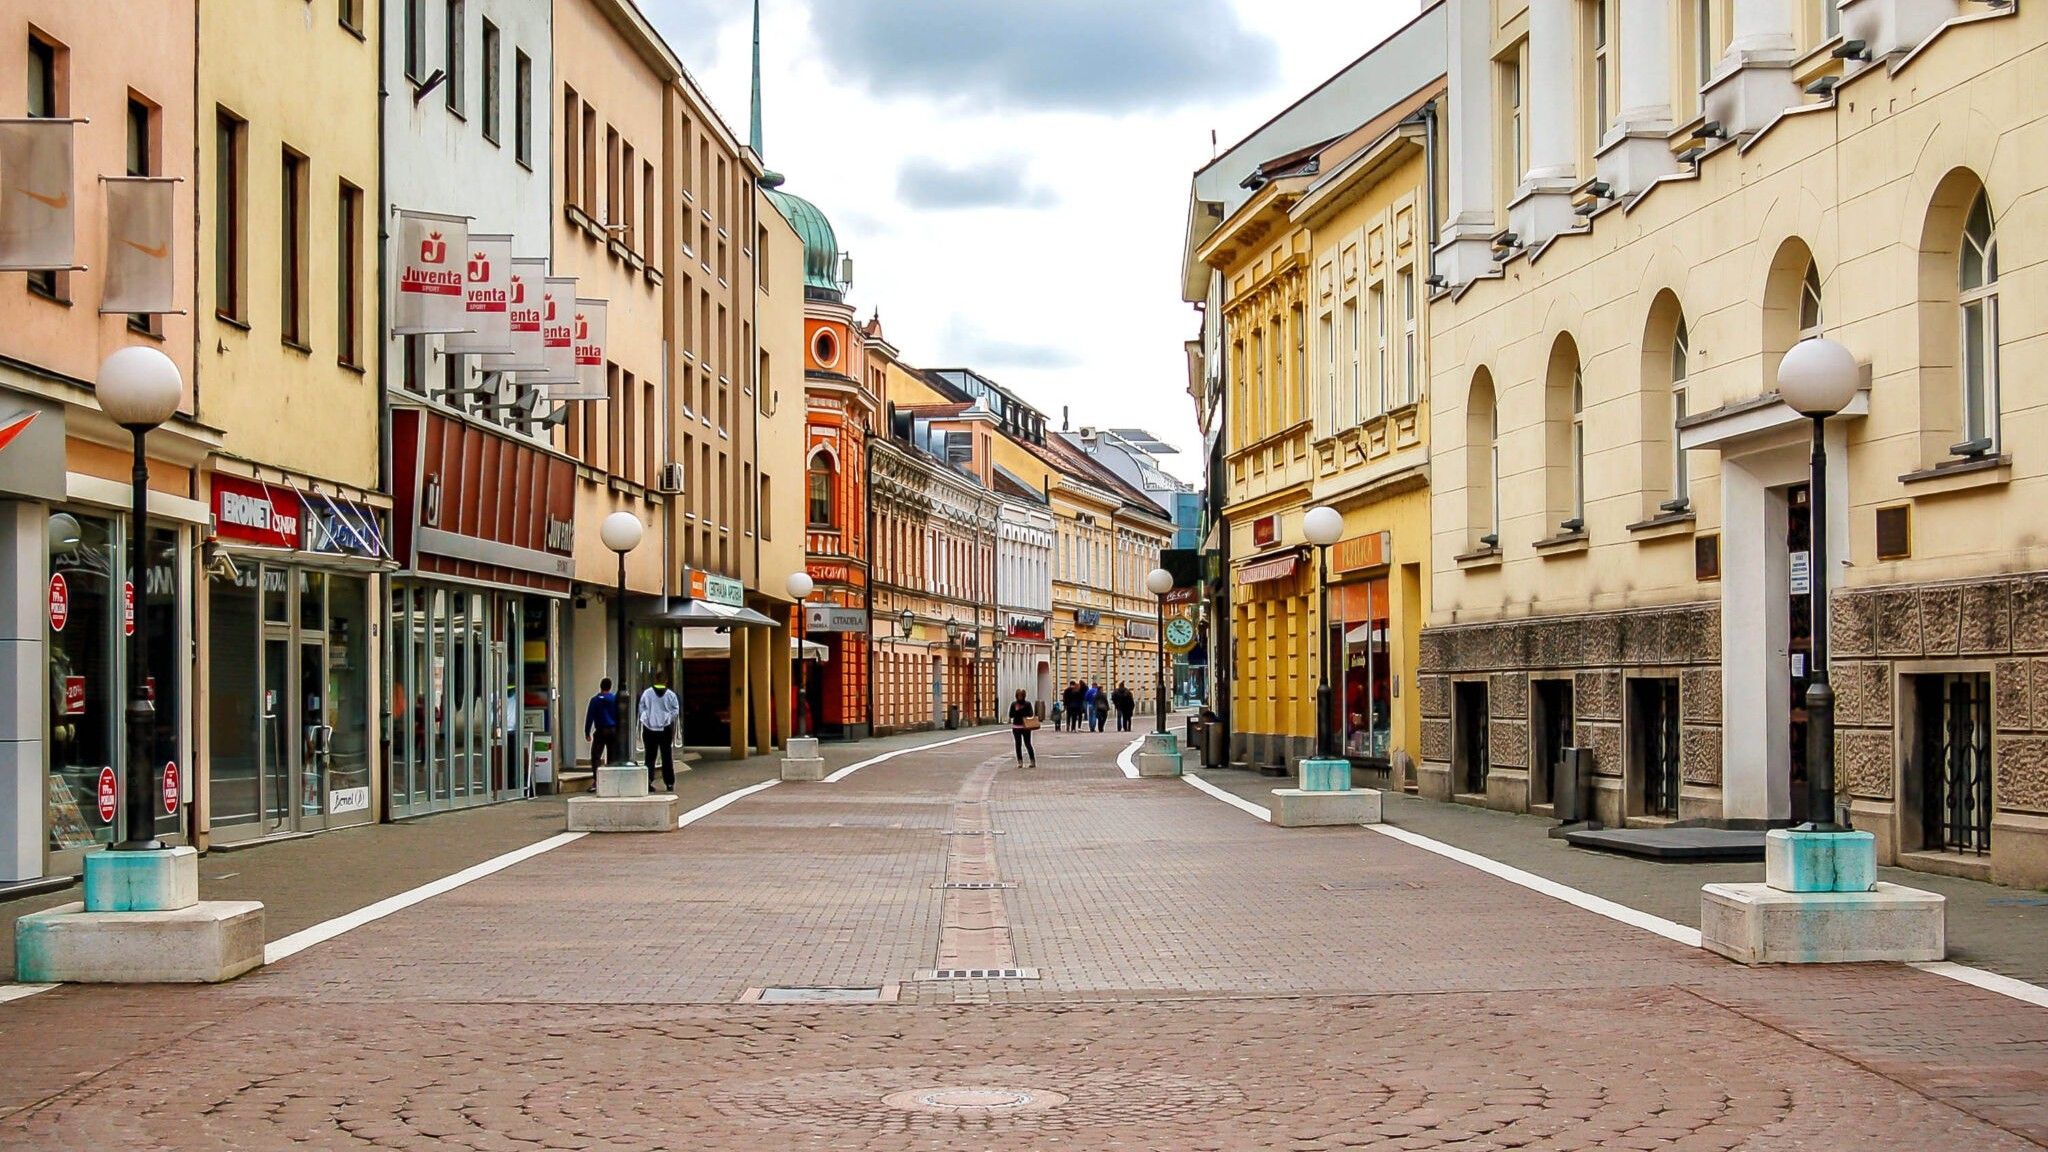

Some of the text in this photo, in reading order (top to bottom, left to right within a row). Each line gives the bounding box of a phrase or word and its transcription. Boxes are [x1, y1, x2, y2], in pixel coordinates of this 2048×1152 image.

[402, 266, 461, 285] Juventa
[467, 288, 506, 302] venta
[511, 308, 540, 321] enta
[544, 325, 571, 338] enta
[575, 344, 601, 357] enta
[221, 491, 271, 530] ERONET
[832, 616, 864, 626] CITADELA
